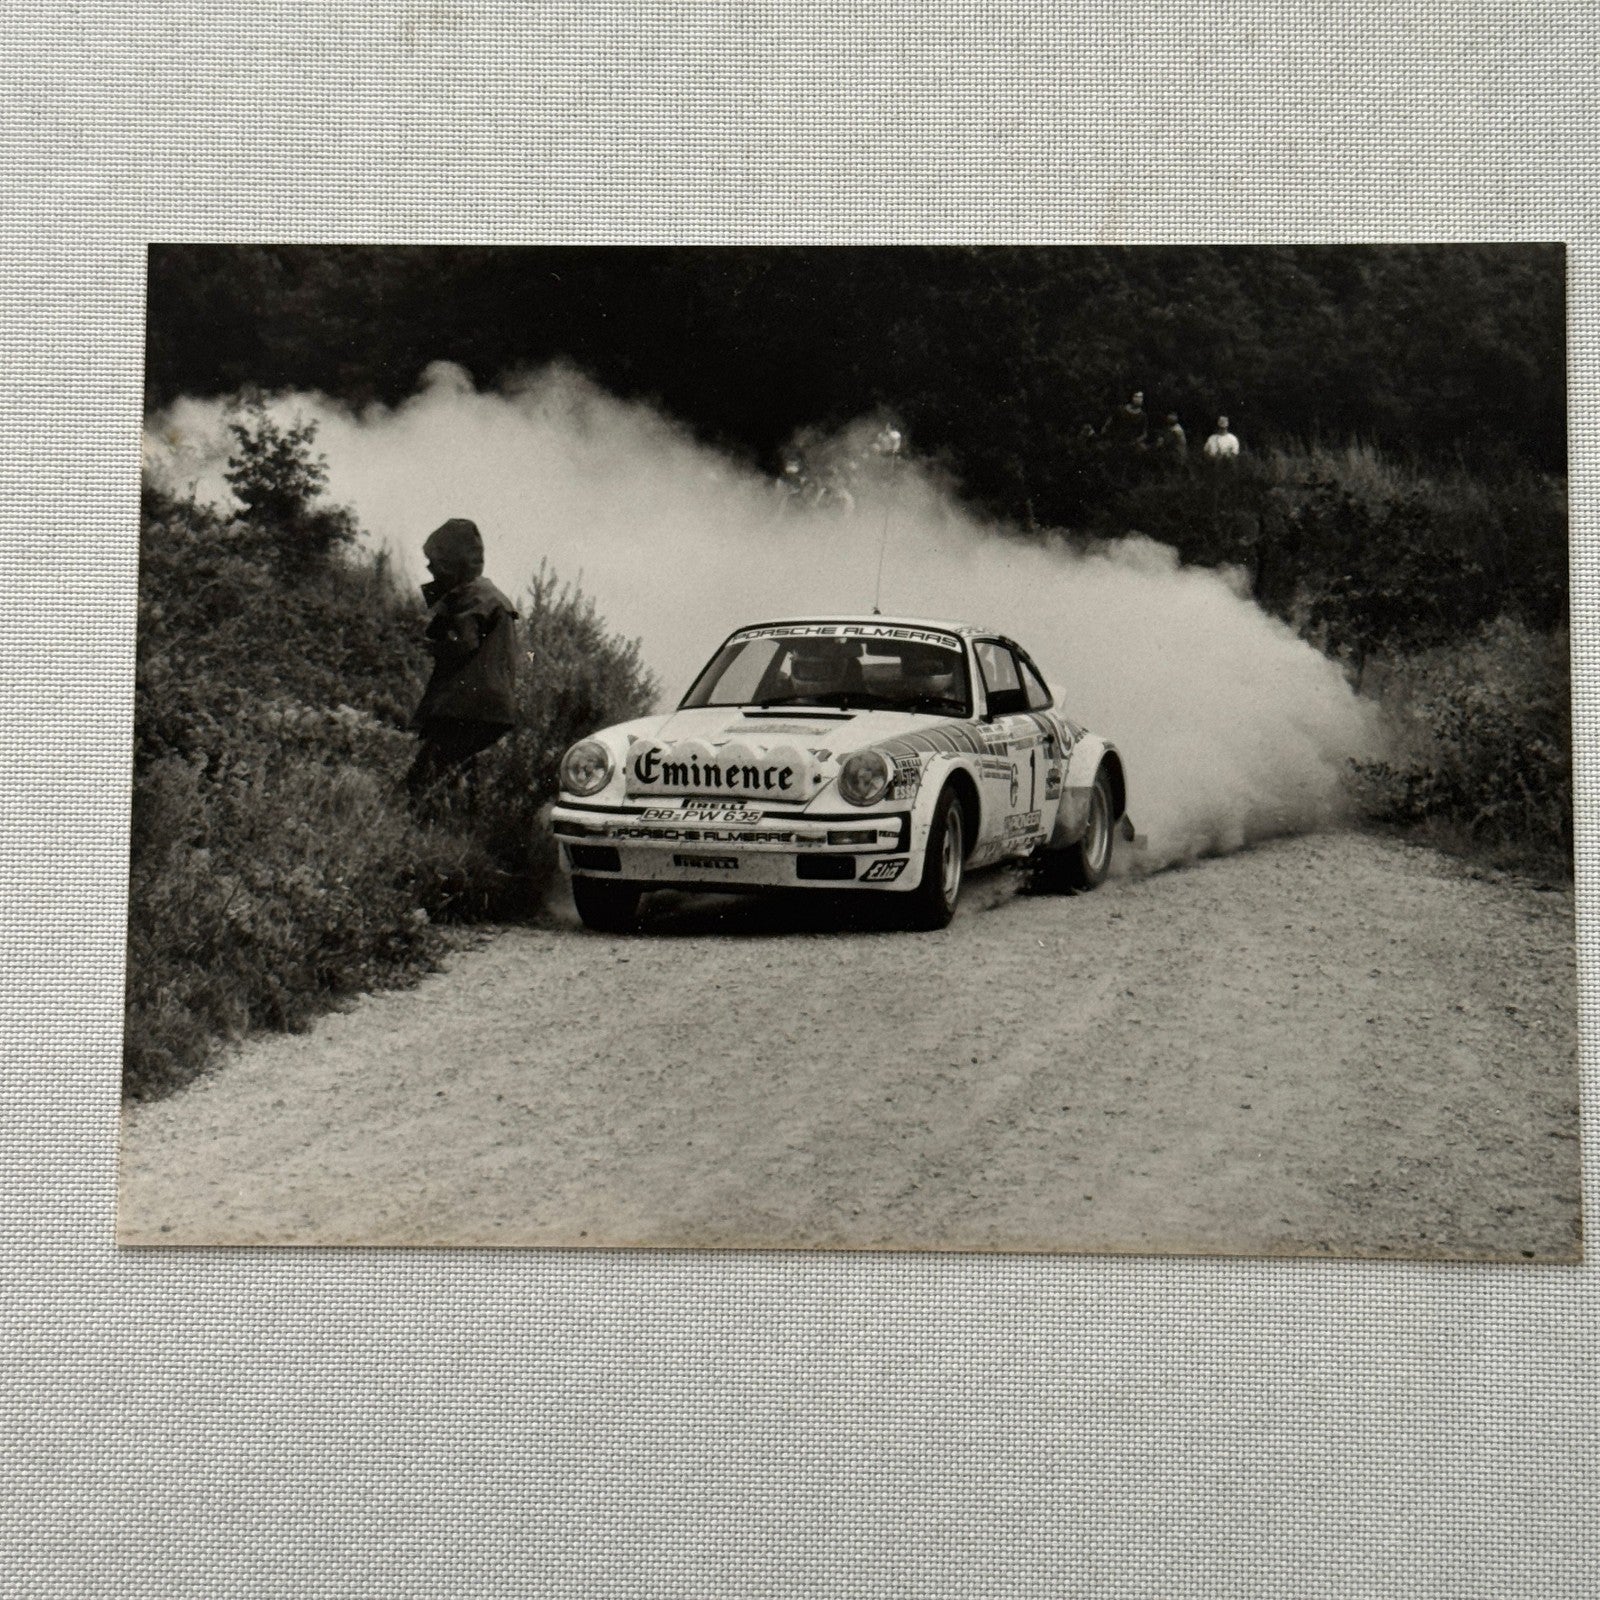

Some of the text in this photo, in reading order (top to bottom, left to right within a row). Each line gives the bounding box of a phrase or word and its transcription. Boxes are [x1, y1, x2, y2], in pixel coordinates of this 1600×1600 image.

[732, 625, 837, 643] PORSCHE
[634, 747, 794, 790] Eminence
[723, 810, 760, 822] 635
[617, 828, 700, 841] PORSCHE
